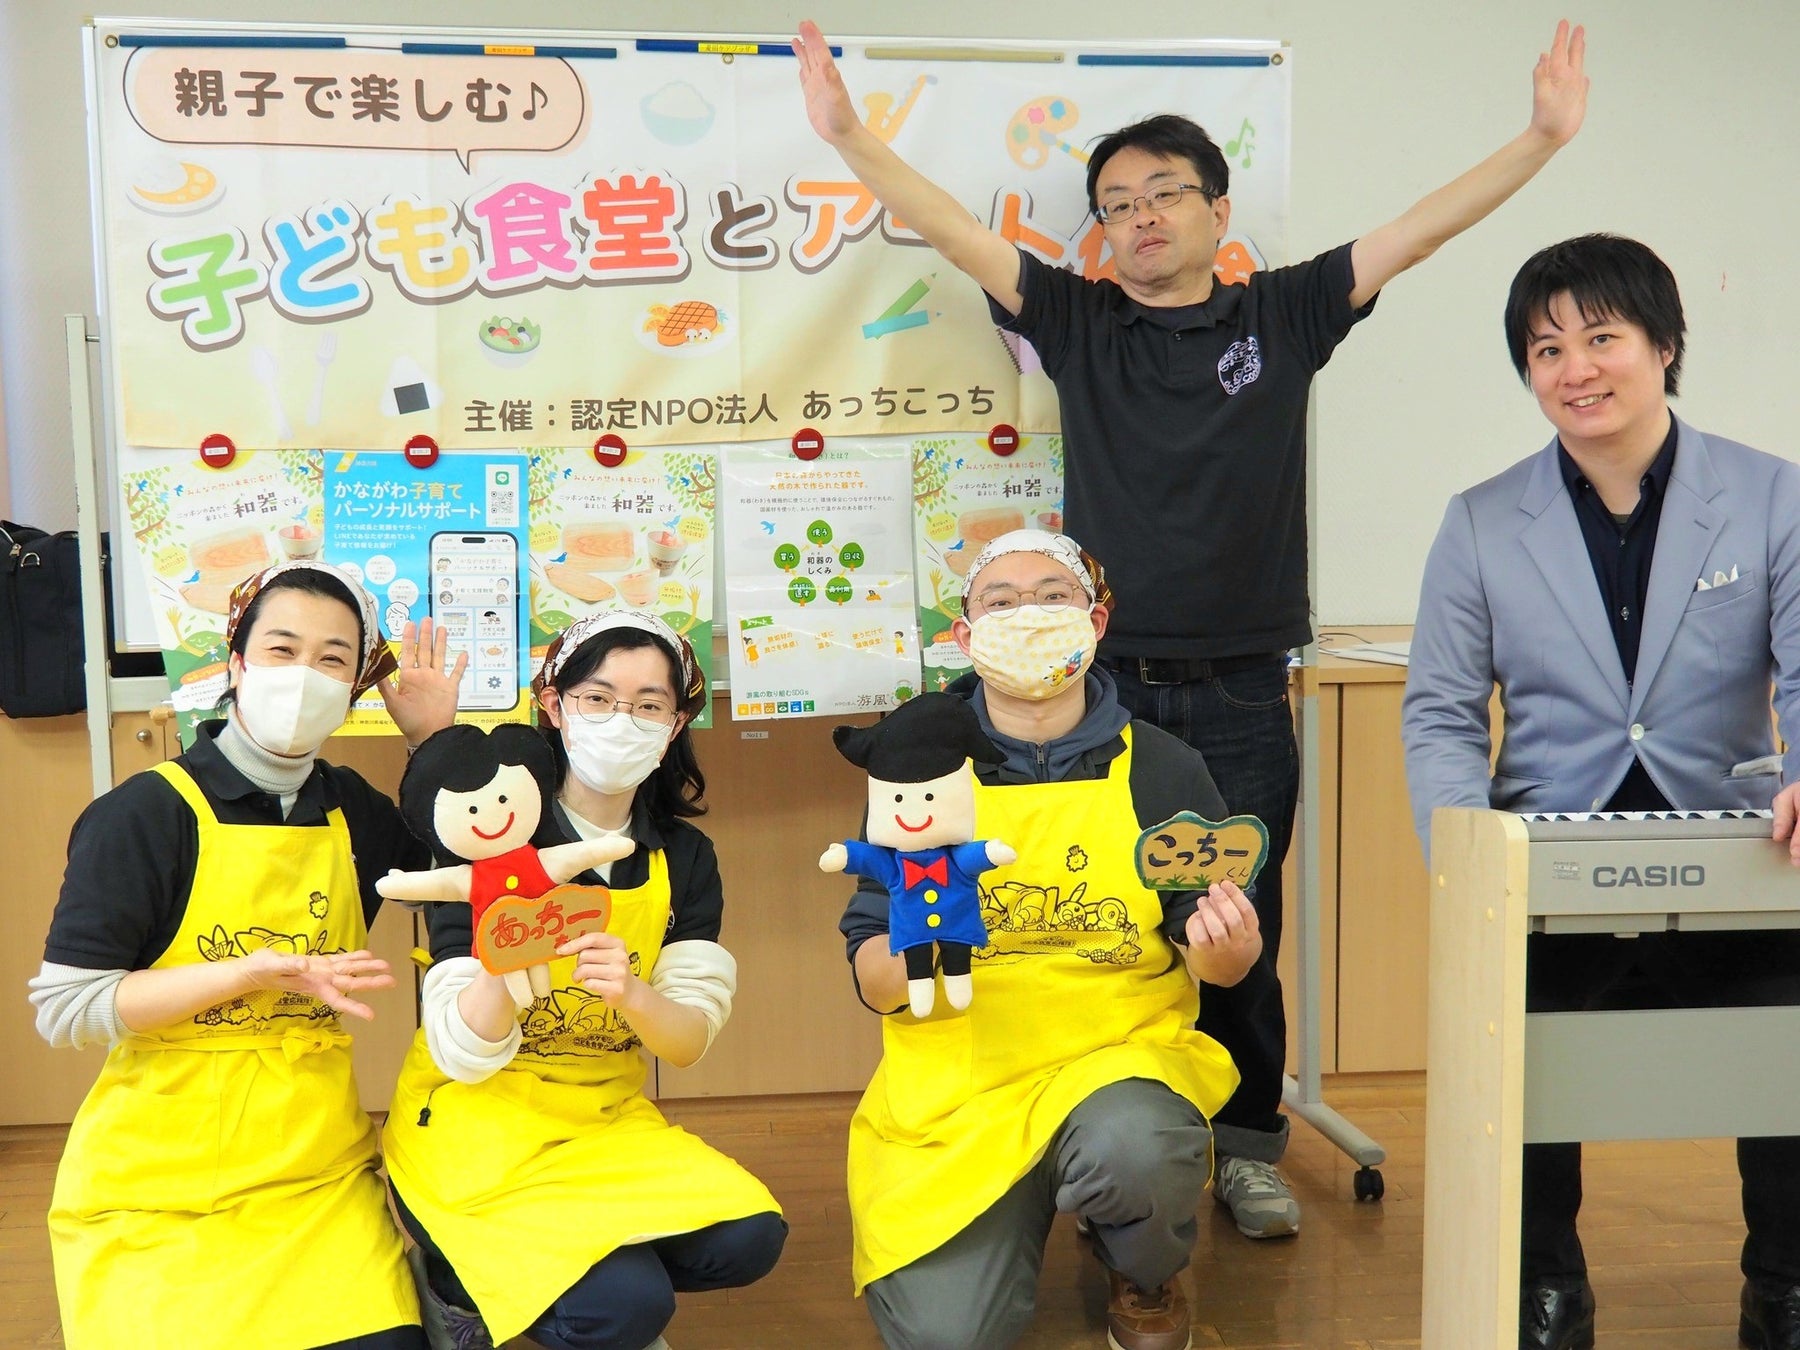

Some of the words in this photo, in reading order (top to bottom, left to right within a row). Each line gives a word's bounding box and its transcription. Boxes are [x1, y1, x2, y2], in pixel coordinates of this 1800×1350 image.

[802, 385, 995, 422] あっちこっち
[333, 481, 464, 500] かながわ子育て
[333, 502, 482, 520] パーソナルサポート
[807, 566, 832, 575] しくみ
[1147, 832, 1249, 868] こっちー
[1226, 866, 1250, 879] くん
[1592, 864, 1706, 888] CASIO
[490, 900, 603, 949] あっちー
